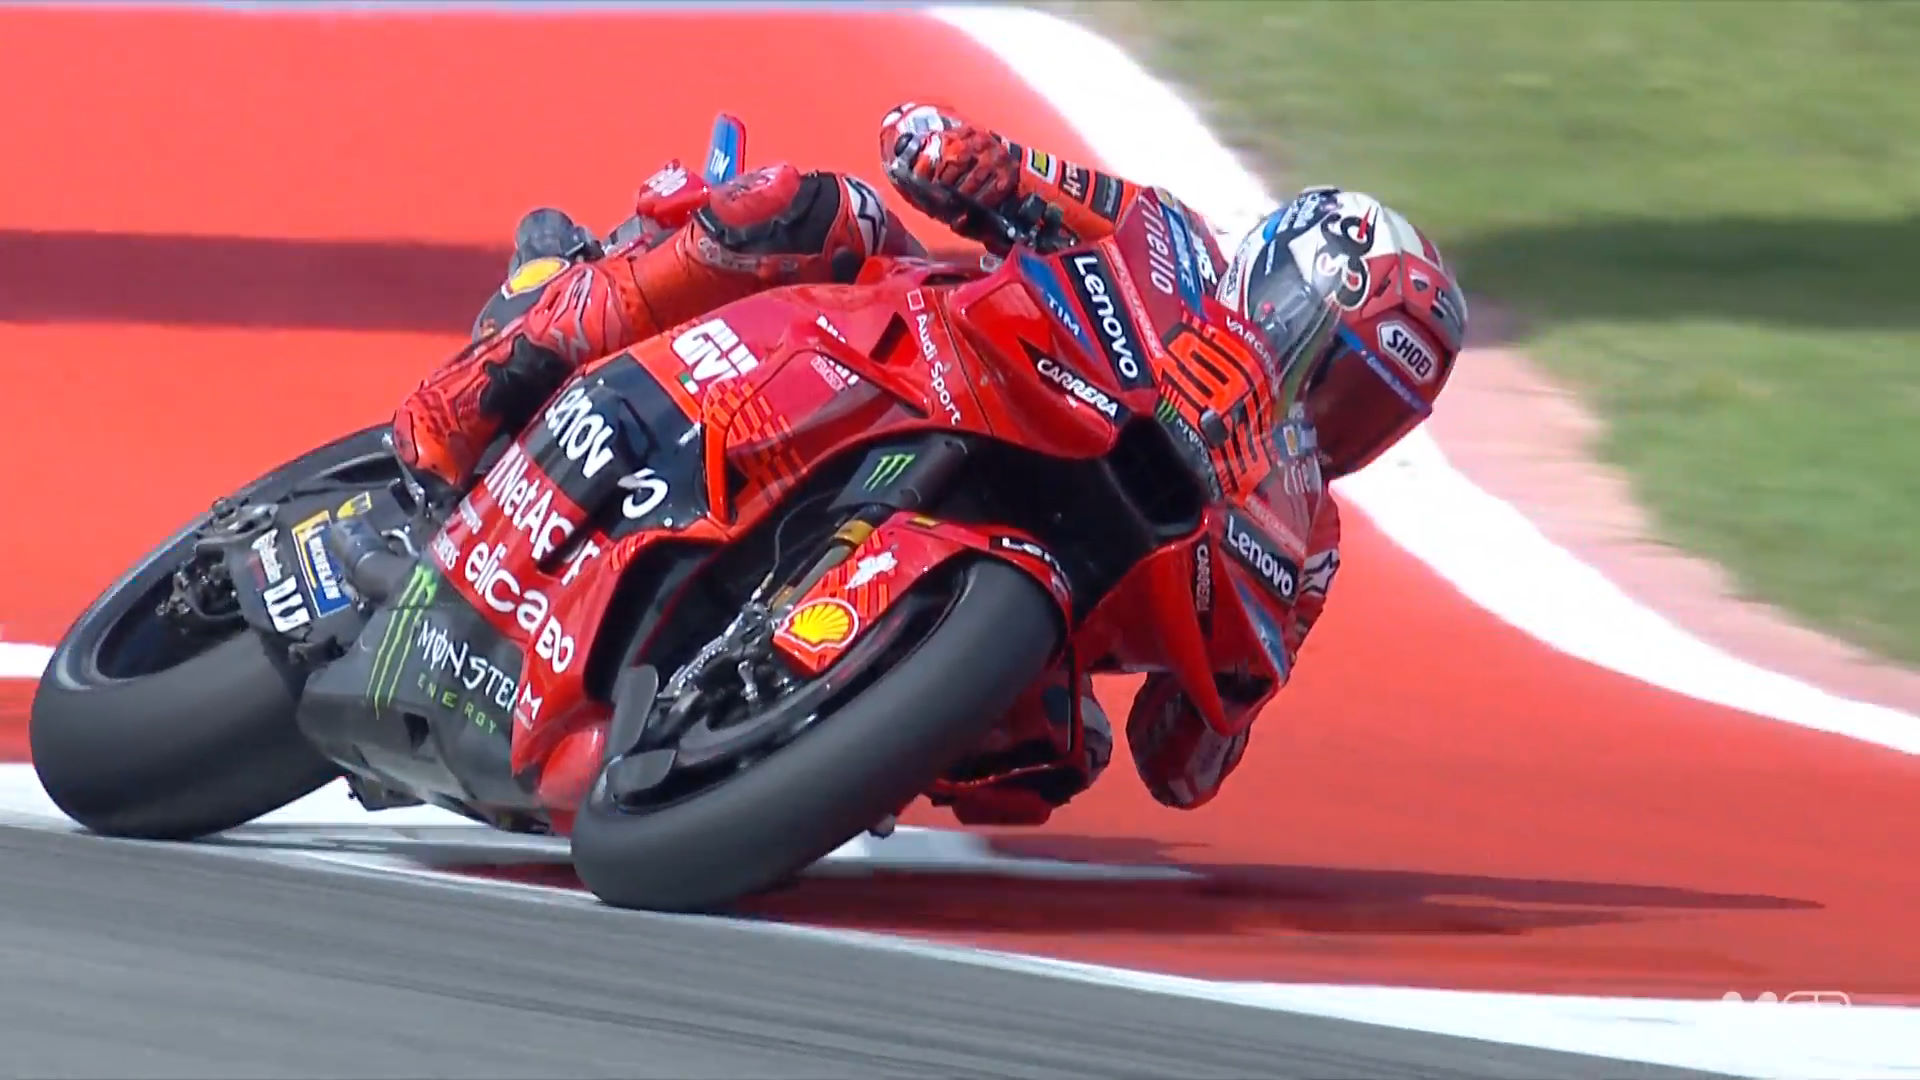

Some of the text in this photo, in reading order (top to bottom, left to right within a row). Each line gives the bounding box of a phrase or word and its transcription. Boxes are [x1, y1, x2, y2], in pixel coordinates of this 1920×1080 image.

[1046, 292, 1081, 336] TIM
[1073, 254, 1139, 379] Lenovo
[915, 313, 962, 426] Audi Sport
[1386, 328, 1434, 380] SHOEI
[1036, 358, 1118, 420] CARRERA
[1227, 515, 1294, 596] Lenovo
[416, 672, 497, 734] ENERGY
